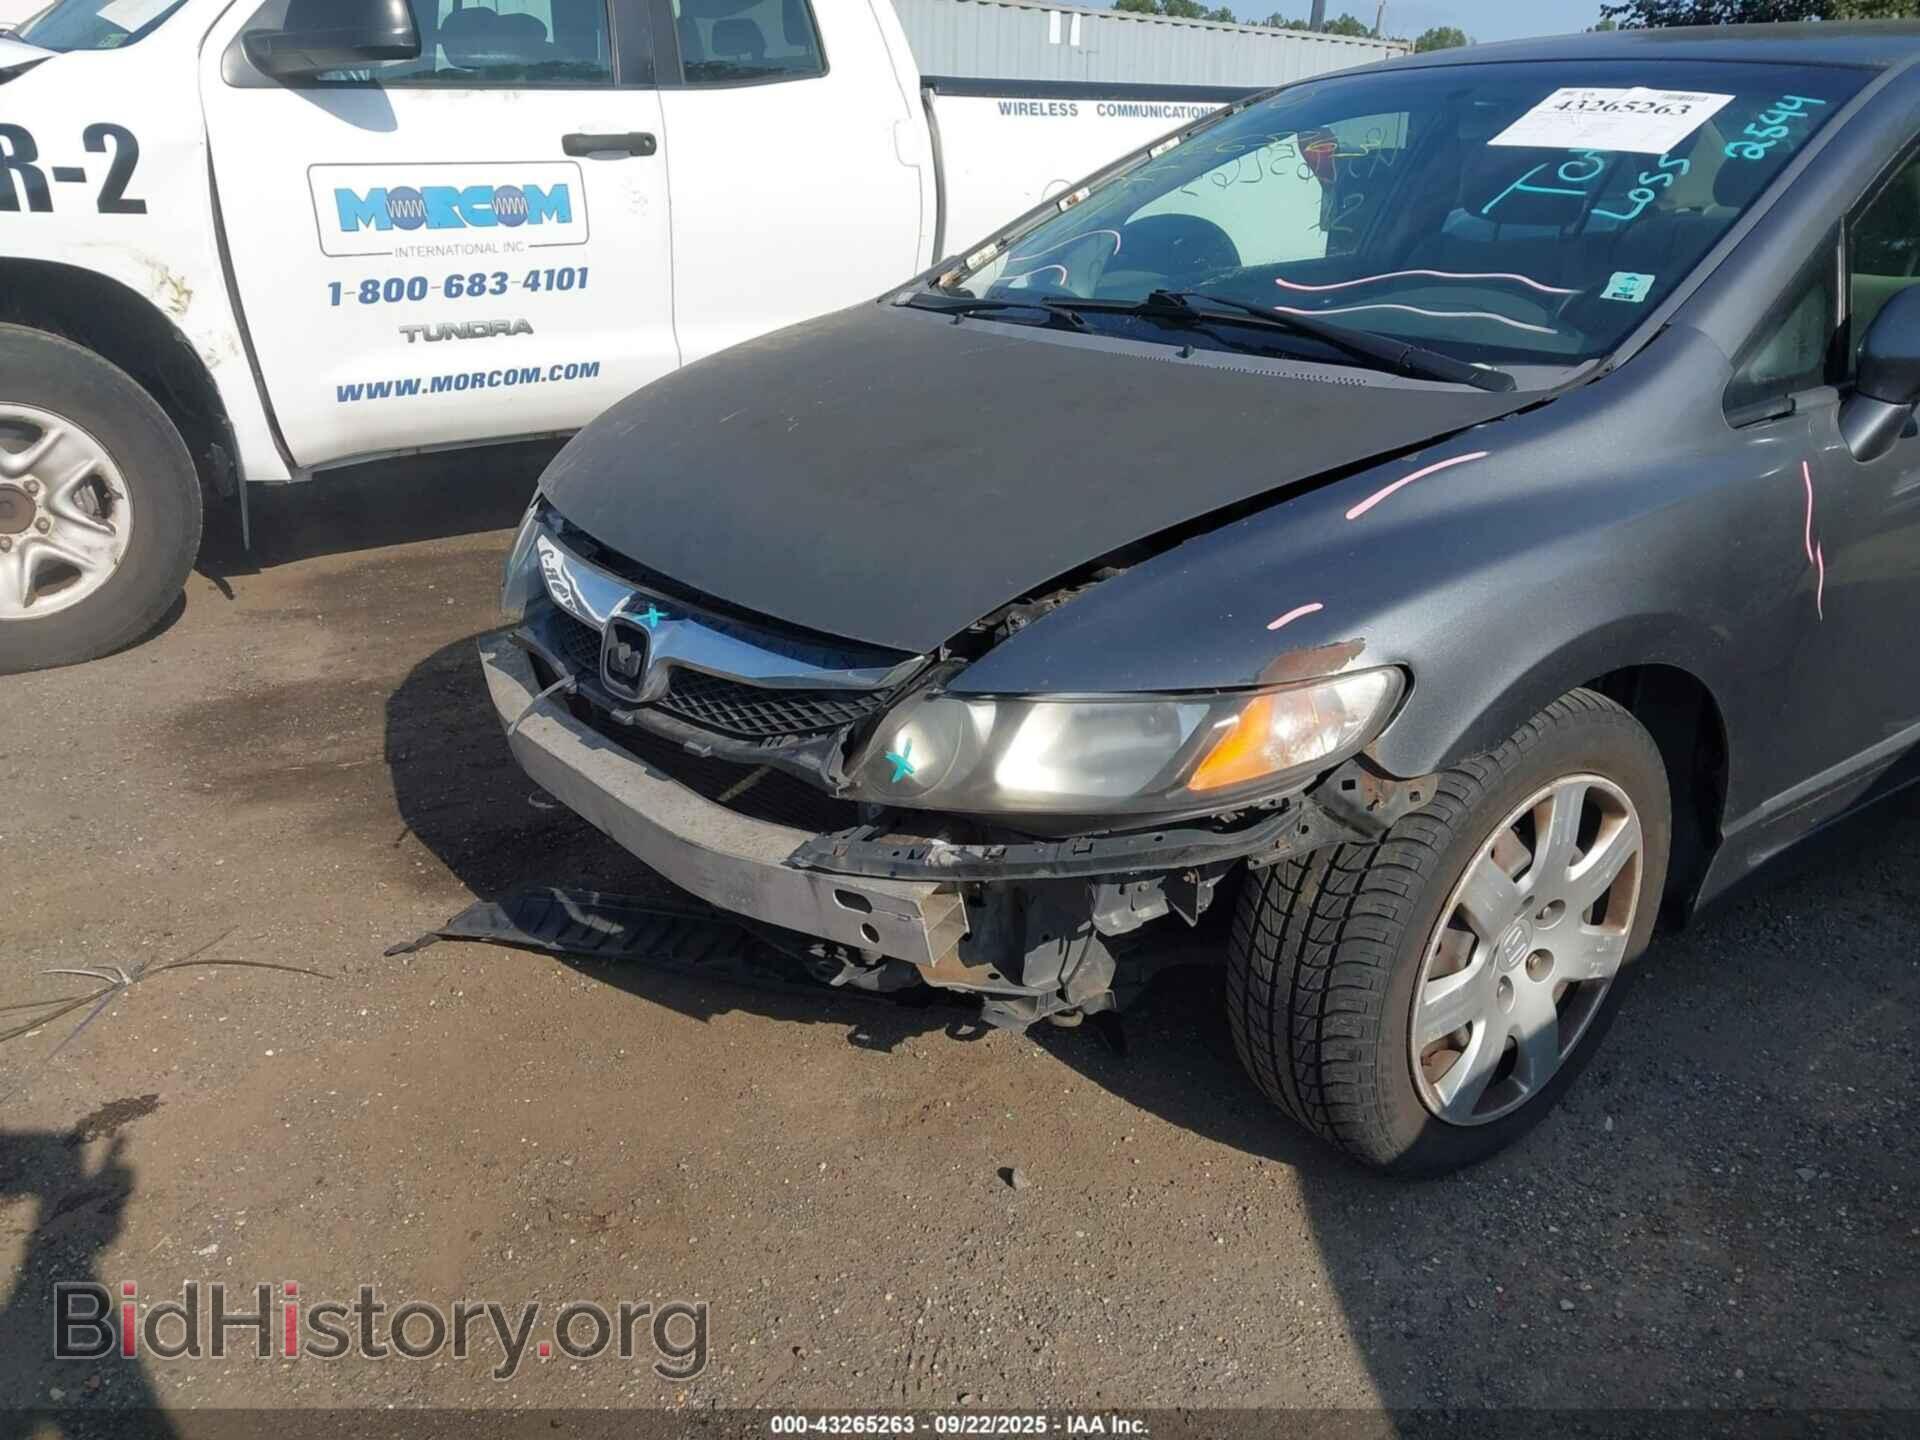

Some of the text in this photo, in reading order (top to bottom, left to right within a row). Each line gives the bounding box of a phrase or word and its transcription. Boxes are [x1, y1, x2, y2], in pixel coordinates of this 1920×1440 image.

[998, 102, 1078, 116] WIRELESS
[1554, 99, 1692, 117] 43265263
[1724, 95, 1826, 160] 2544
[333, 183, 572, 232] MORCOM
[395, 241, 525, 259] INTERNATIONAL INC
[327, 266, 589, 306] 1-800-683-4101
[398, 318, 534, 343] TUNDRA
[336, 361, 600, 402] WWW.MORCOM.COM
